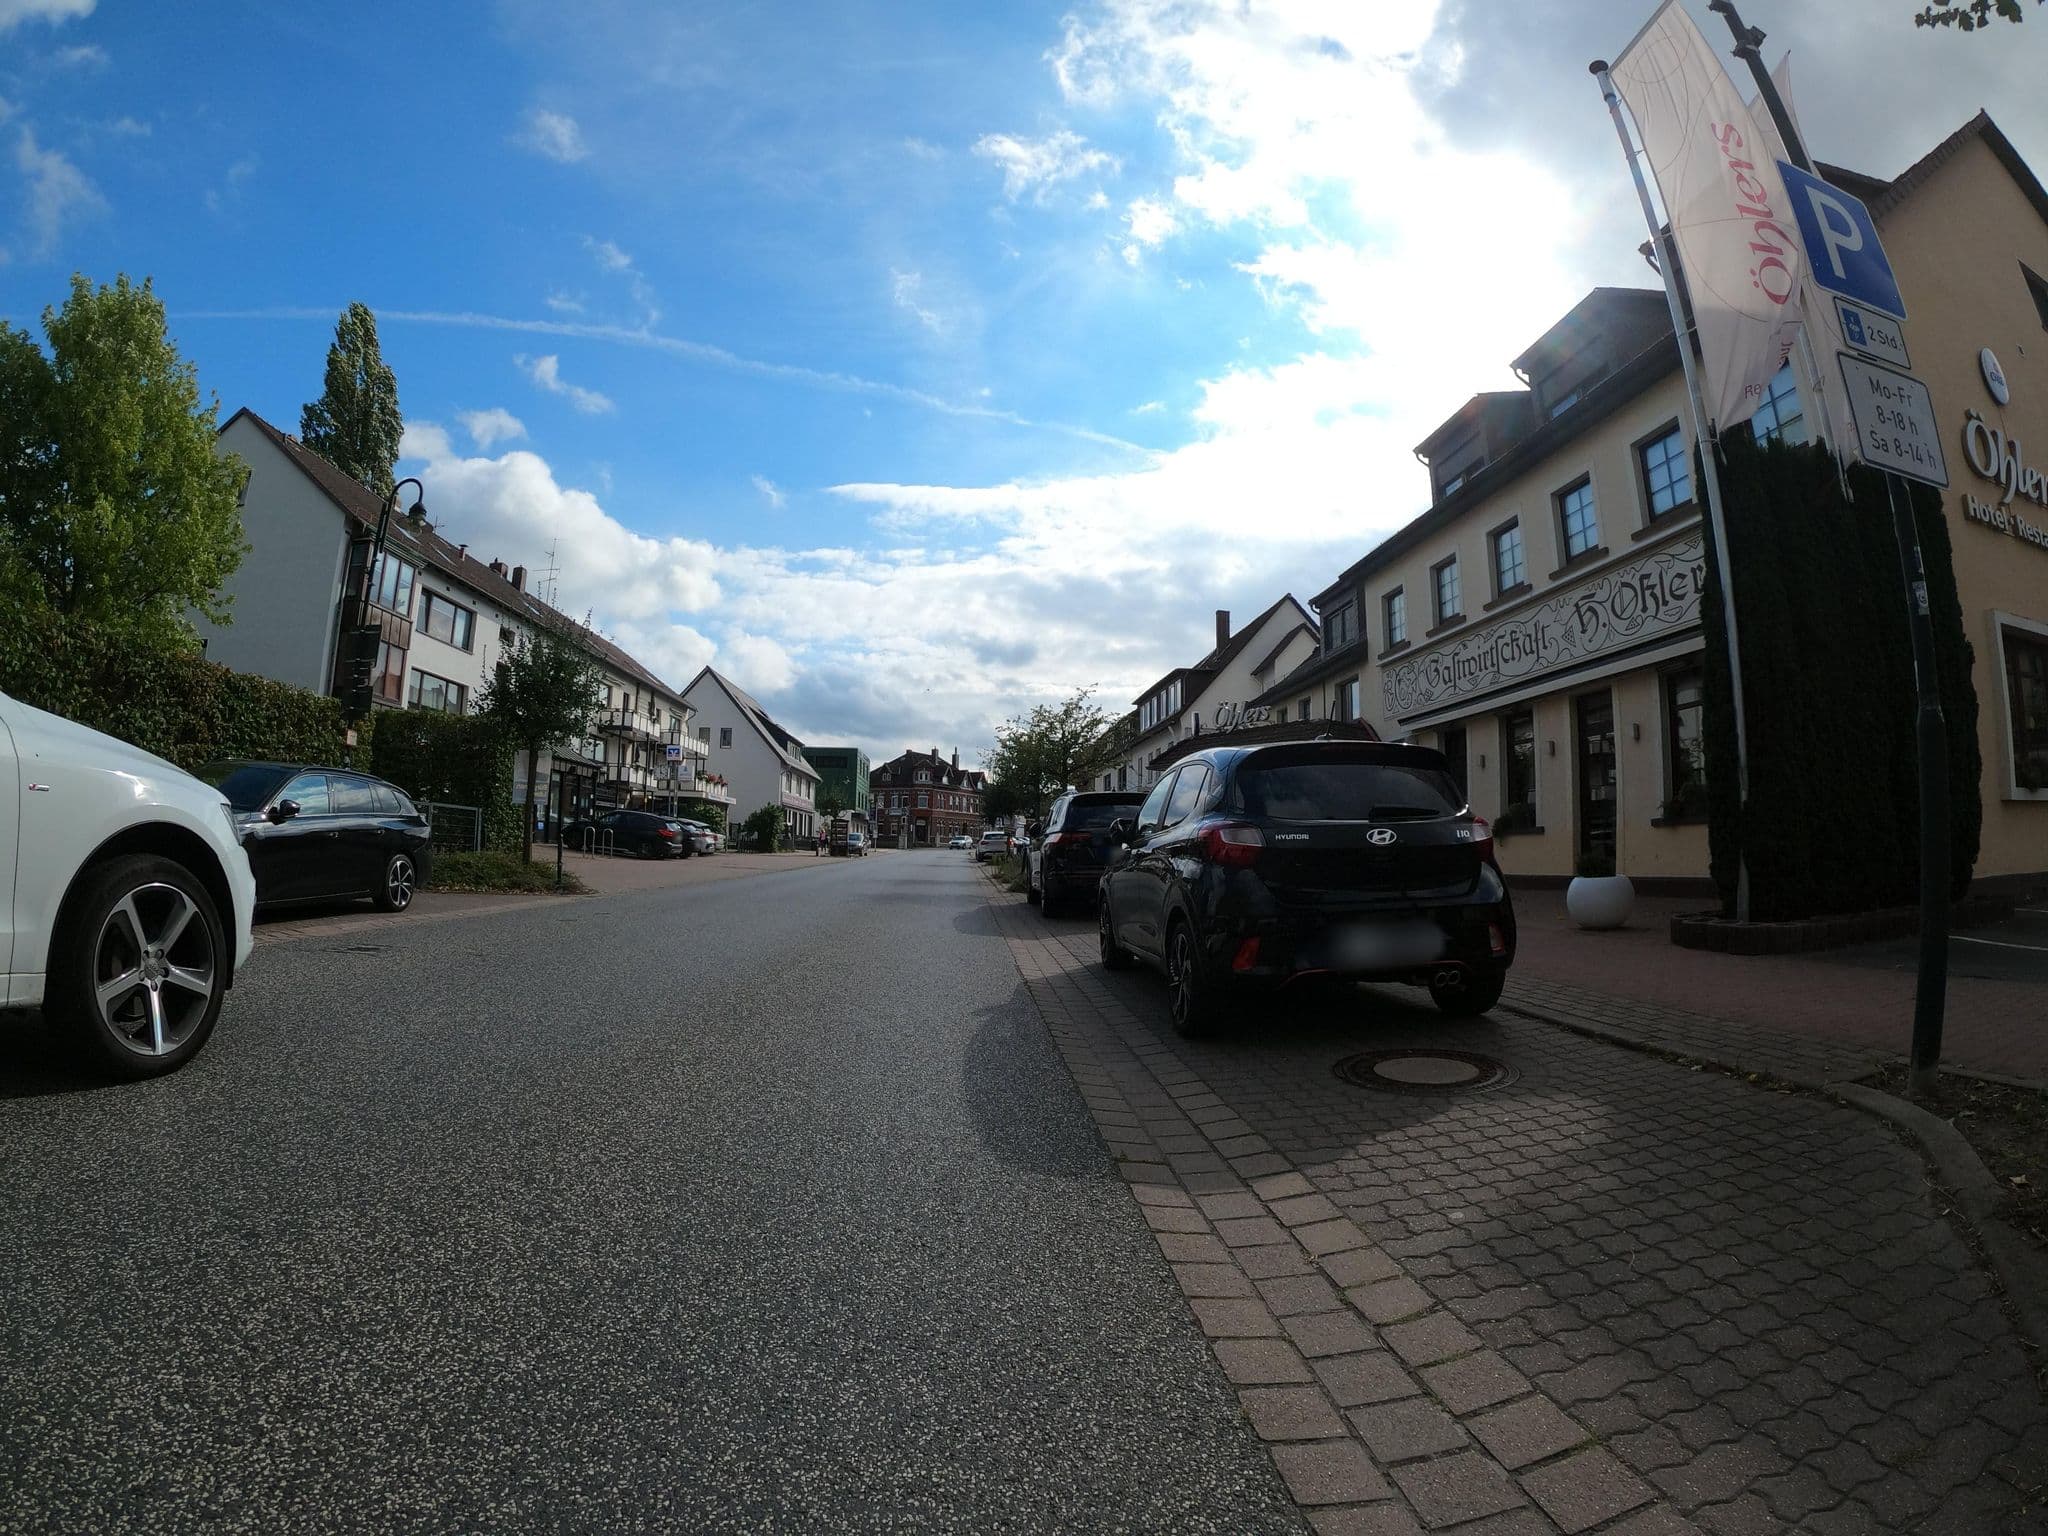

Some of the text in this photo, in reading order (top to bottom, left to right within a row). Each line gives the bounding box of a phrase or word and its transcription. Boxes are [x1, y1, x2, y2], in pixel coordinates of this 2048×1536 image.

[1711, 122, 1799, 305] Öhlers
[1804, 185, 1863, 279] P
[1867, 326, 1902, 351] 2 Std.
[1868, 376, 1913, 407] Mo-Fr
[1876, 405, 1906, 431] 8-18
[1909, 416, 1918, 436] h
[1869, 430, 1937, 470] Sa 8-14 h
[1966, 494, 2010, 532] Hotel
[1215, 701, 1272, 734] Öhlers
[1275, 832, 1310, 841] HYUNDAI
